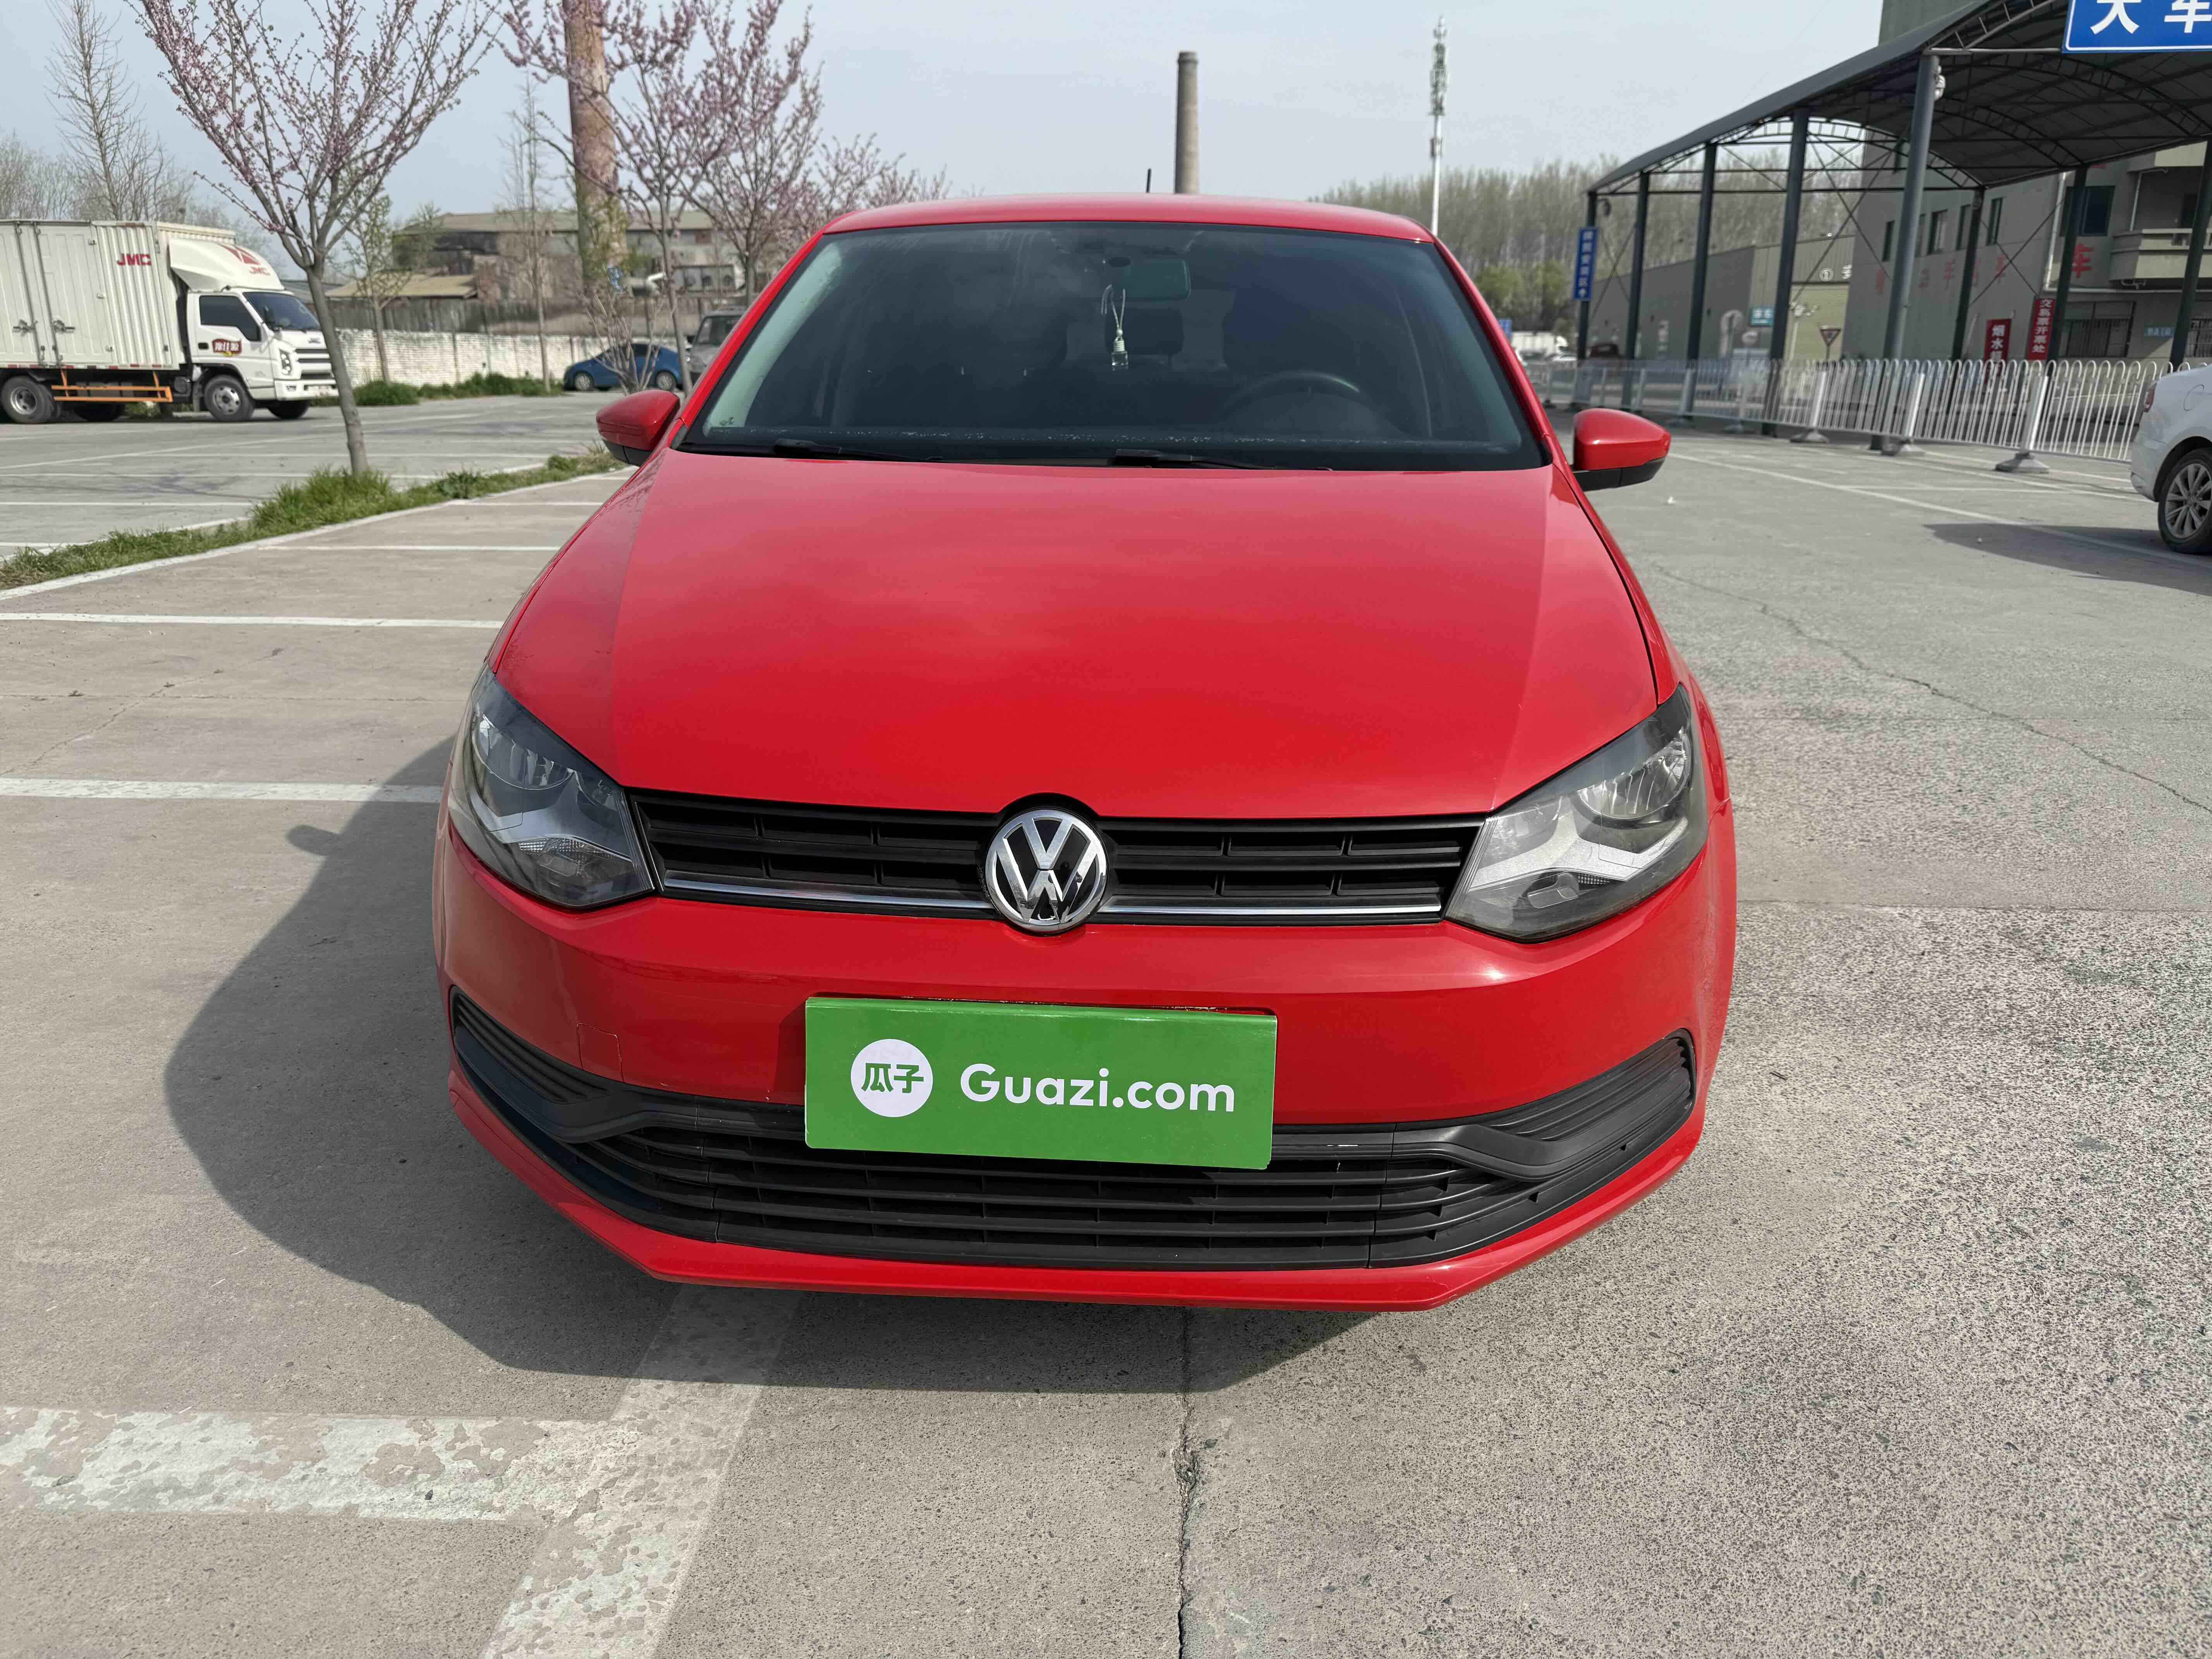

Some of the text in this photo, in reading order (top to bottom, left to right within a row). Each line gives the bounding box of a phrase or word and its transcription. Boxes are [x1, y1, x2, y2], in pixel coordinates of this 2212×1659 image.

[117, 253, 151, 266] JMC
[861, 1063, 924, 1093] 瓜子
[960, 1063, 1235, 1112] Guazi.com
